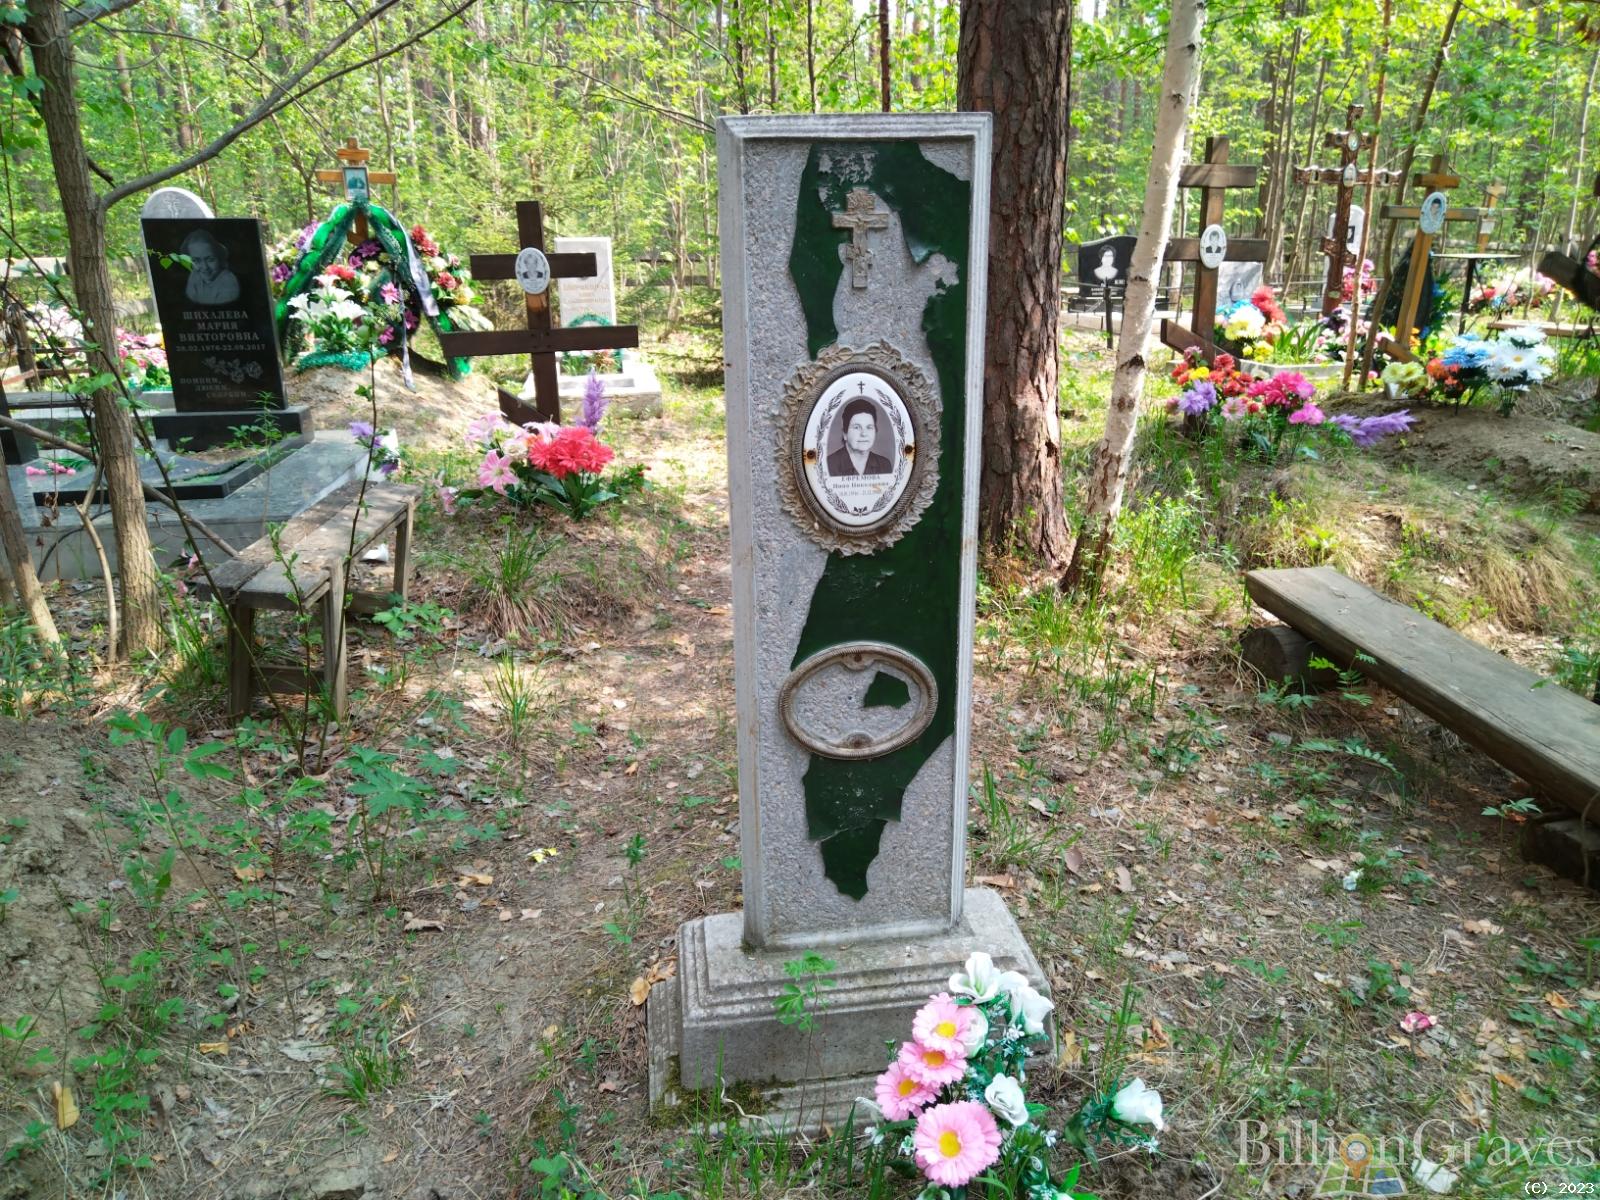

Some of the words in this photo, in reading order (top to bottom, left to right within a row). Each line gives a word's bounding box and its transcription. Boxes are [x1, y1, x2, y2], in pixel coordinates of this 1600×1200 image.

[183, 310, 248, 320] ШИХАЛЕВА
[197, 321, 238, 330] МАРИЯ
[178, 332, 260, 342] ВИКТОРОВНА
